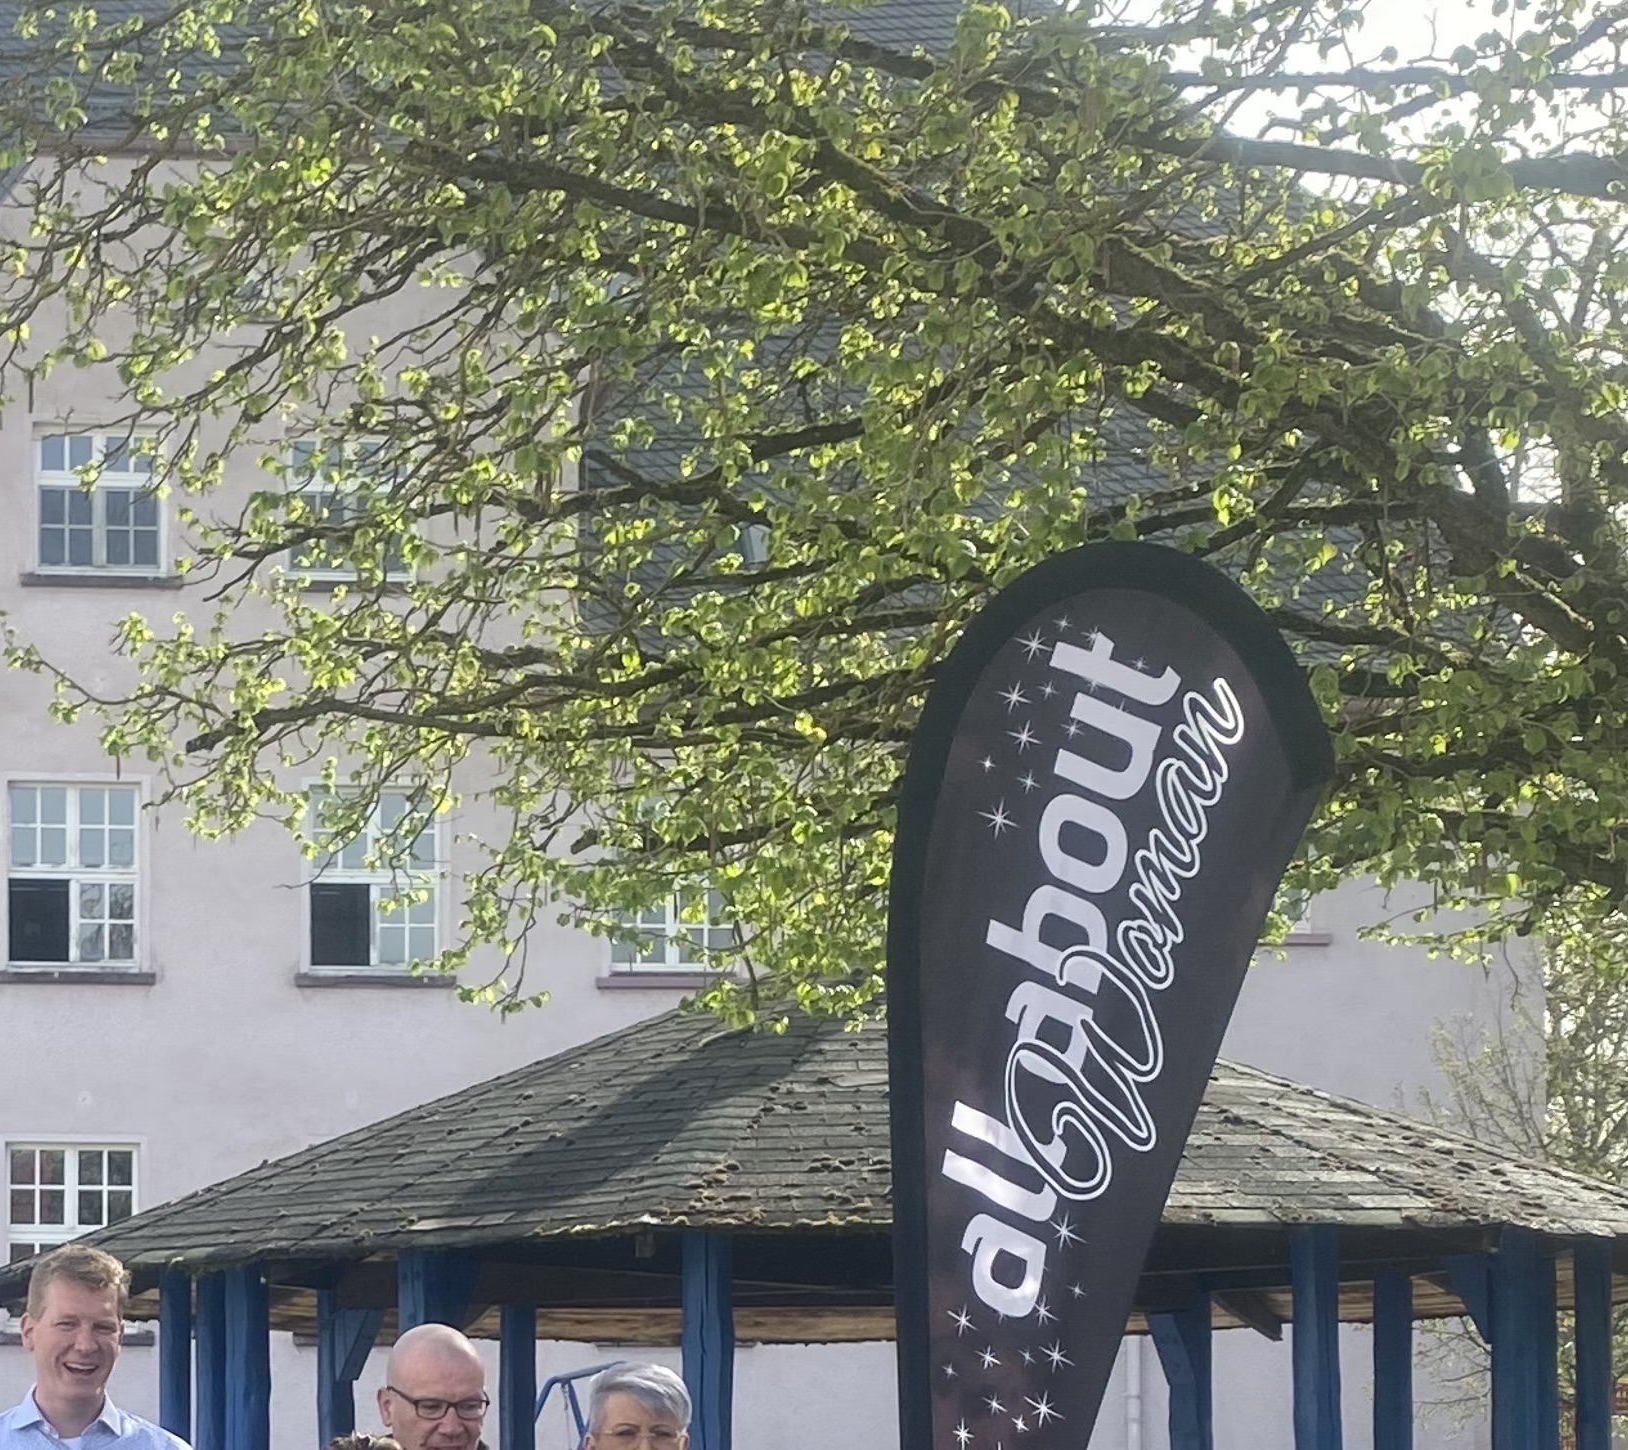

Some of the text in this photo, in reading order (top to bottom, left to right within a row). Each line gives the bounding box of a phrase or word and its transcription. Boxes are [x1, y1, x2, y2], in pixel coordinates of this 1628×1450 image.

[941, 631, 1183, 1320] all about
[1005, 676, 1246, 1202] Woman
